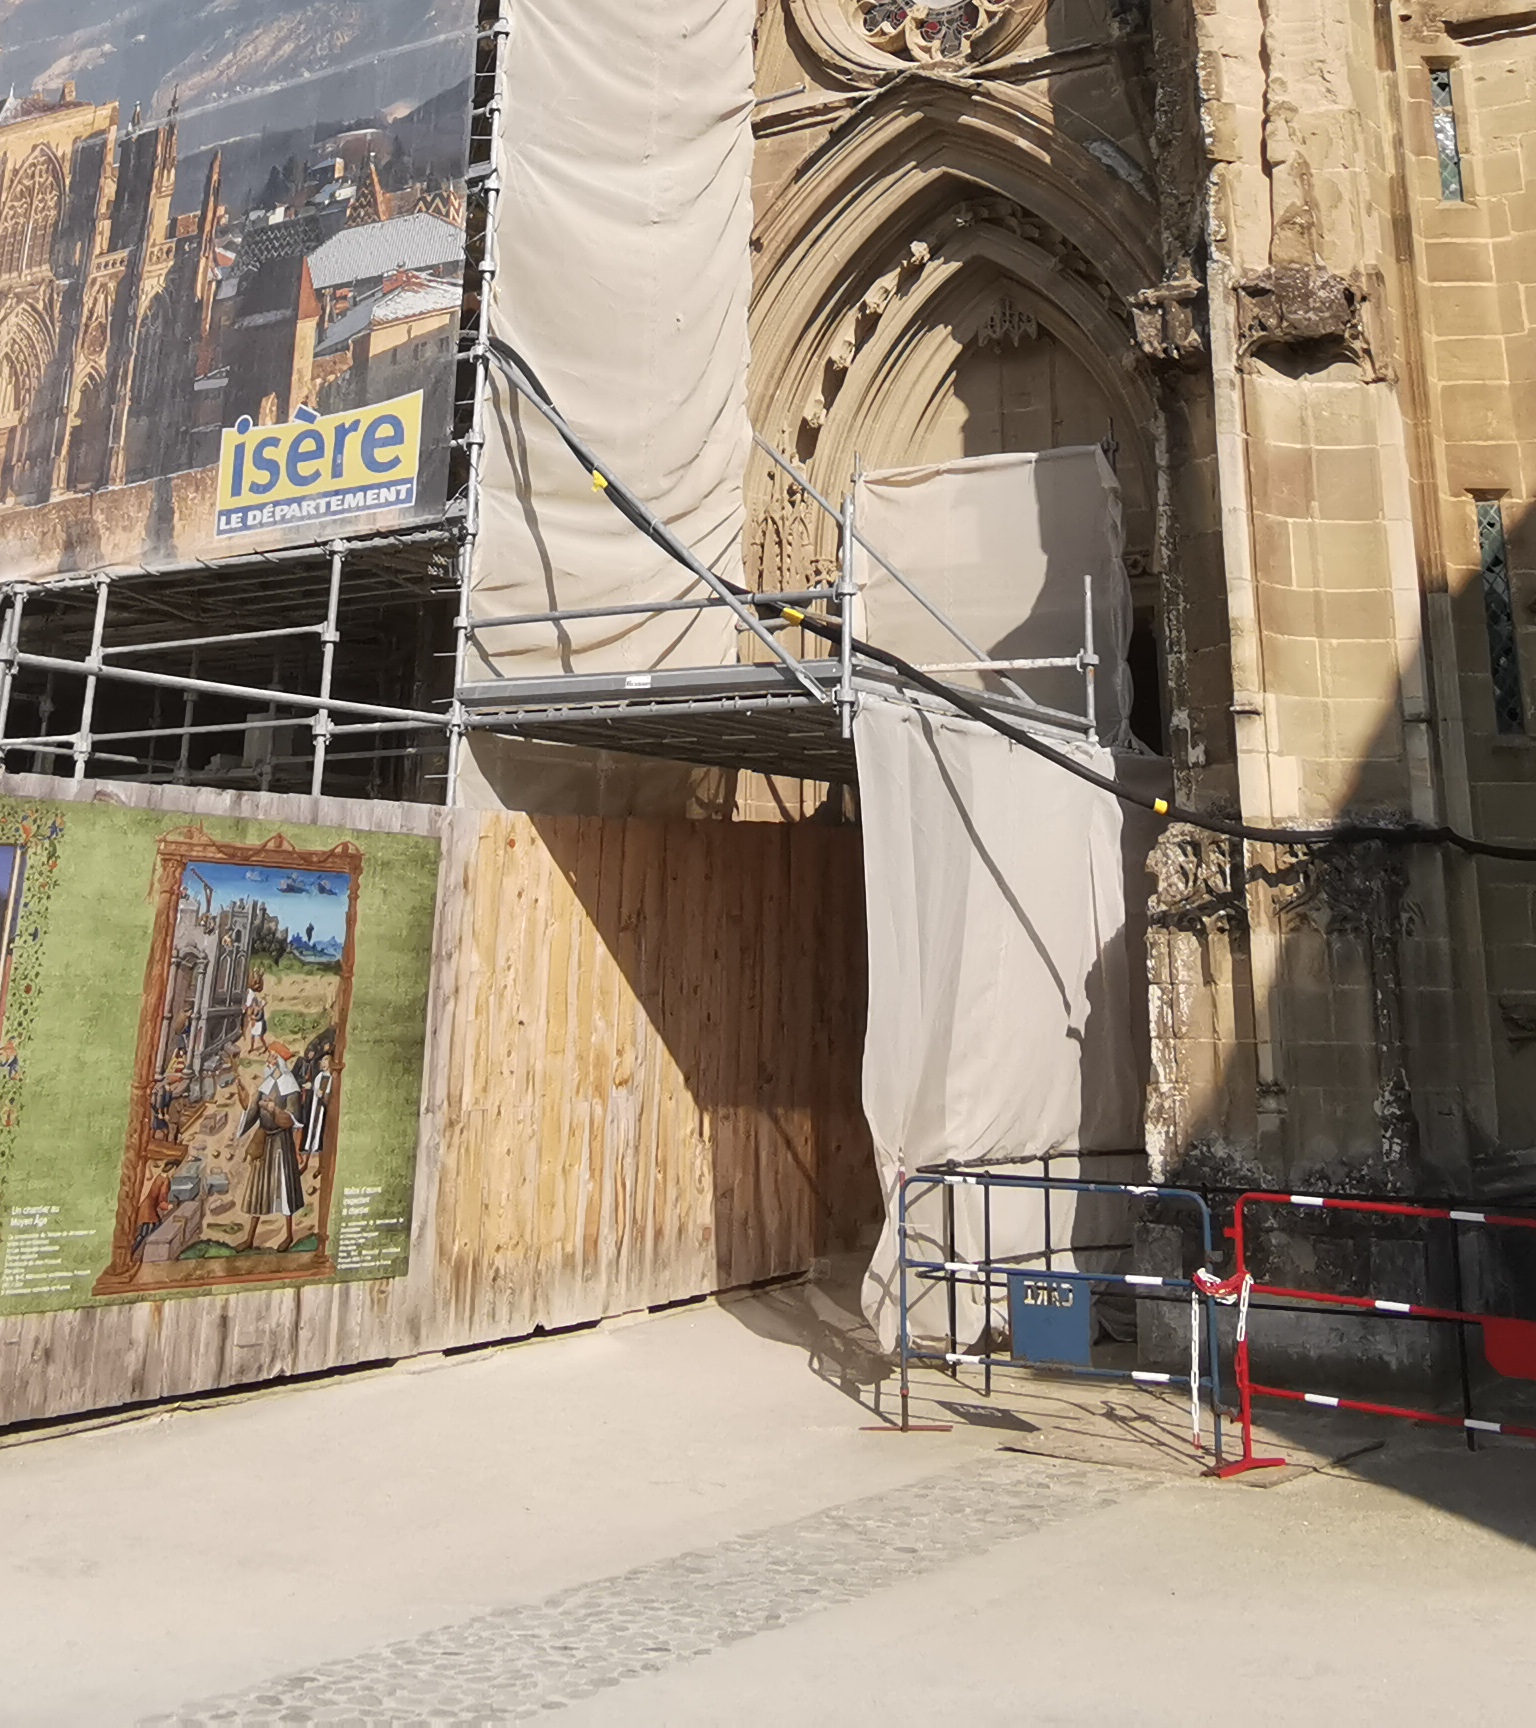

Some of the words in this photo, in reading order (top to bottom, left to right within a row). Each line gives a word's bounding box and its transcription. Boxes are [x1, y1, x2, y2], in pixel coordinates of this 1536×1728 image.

[230, 406, 404, 498] isère
[219, 512, 243, 530] LE
[247, 484, 412, 525] DÉPARTEMENT
